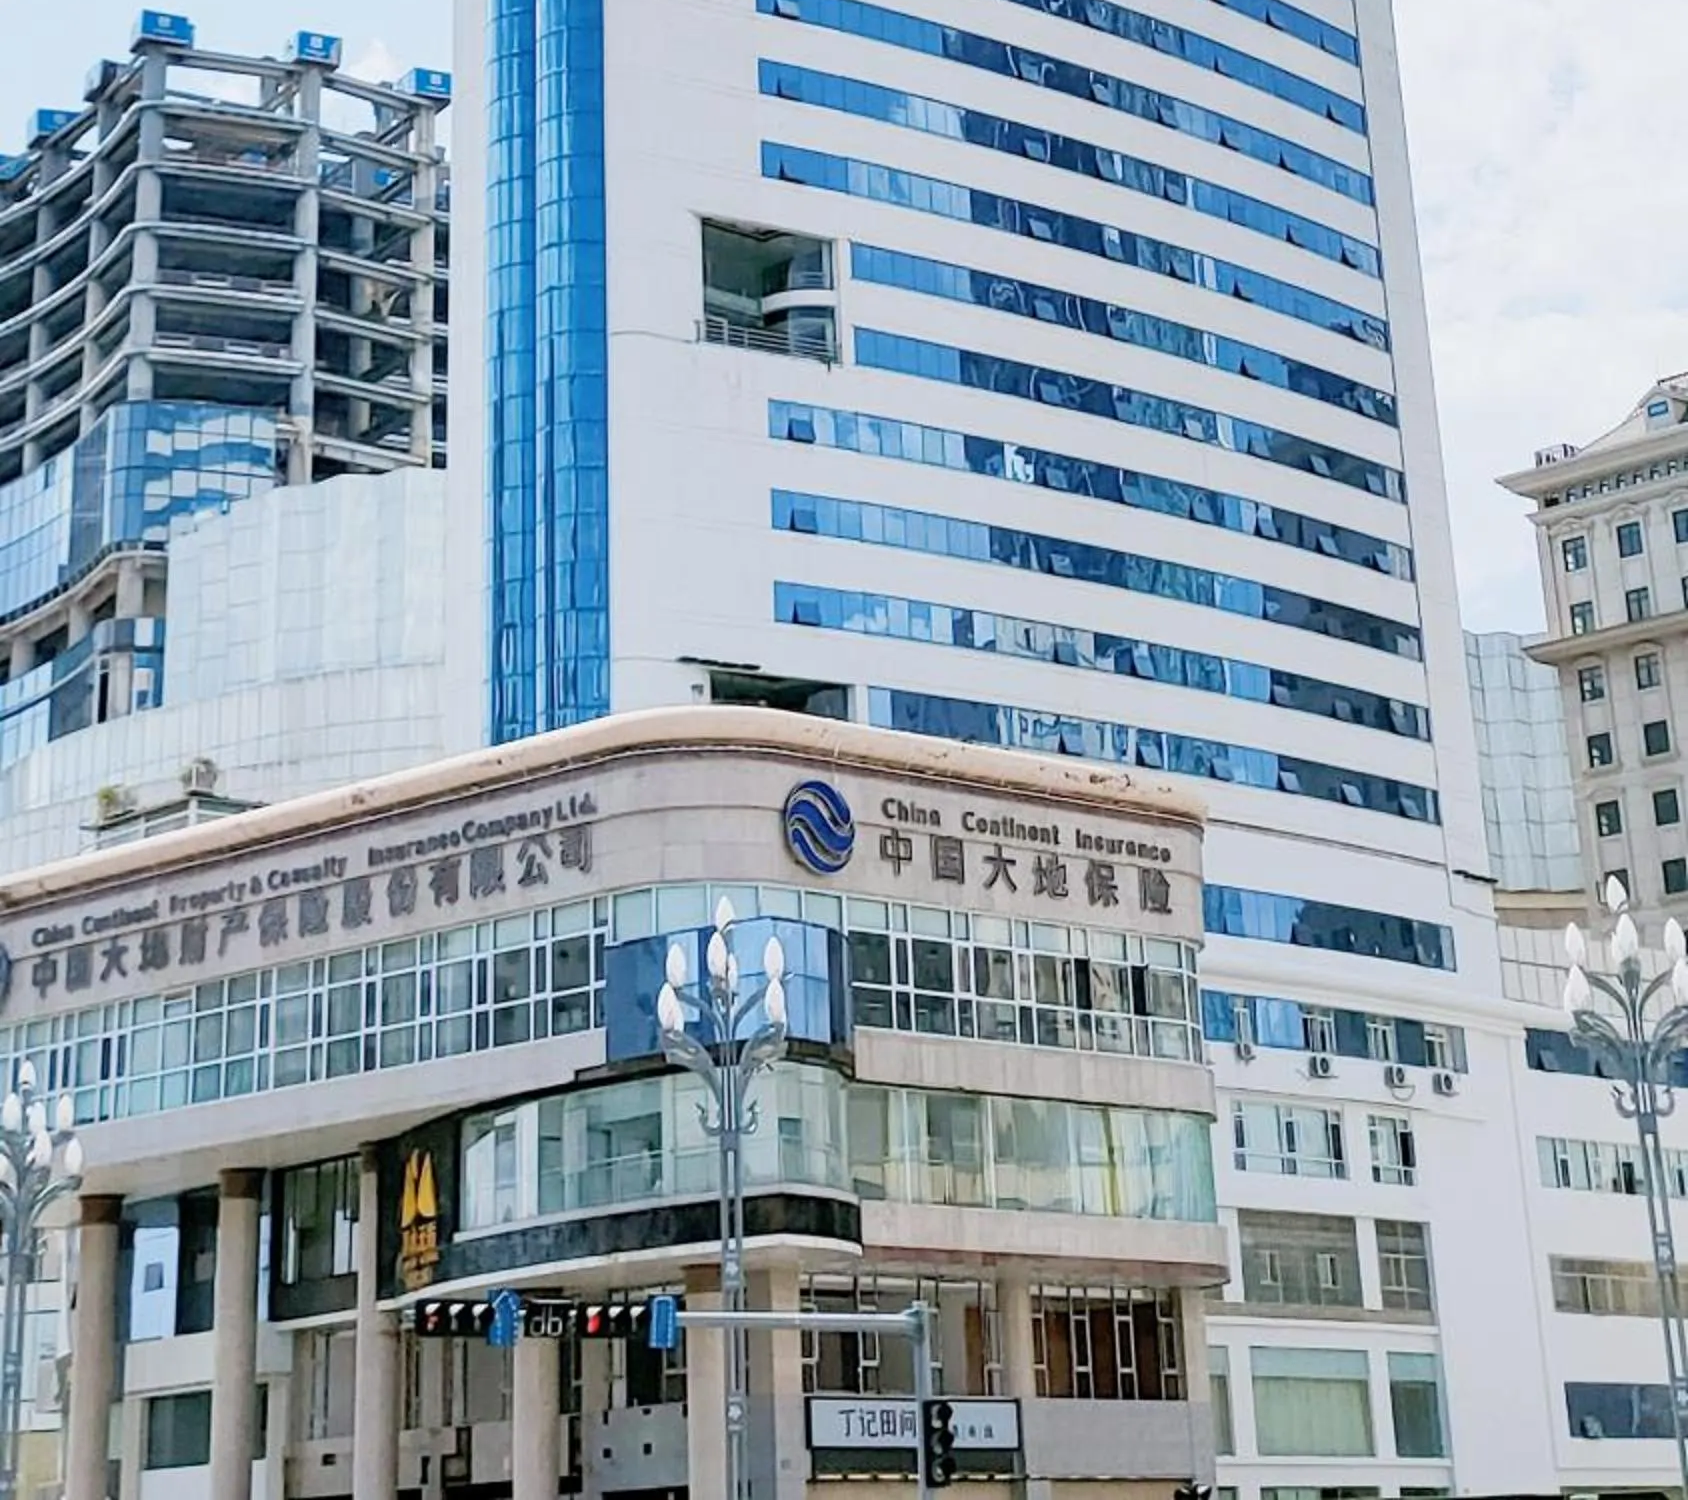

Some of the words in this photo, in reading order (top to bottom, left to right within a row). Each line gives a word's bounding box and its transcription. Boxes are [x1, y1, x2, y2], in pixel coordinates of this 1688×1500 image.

[879, 827, 1173, 915] 中国大地保险
[881, 797, 941, 828] China
[962, 810, 1061, 846] Continent
[1075, 829, 1171, 863] Insurance
[31, 923, 75, 947] China
[81, 899, 159, 936] Continent
[169, 879, 246, 914] Property
[249, 875, 263, 896] &
[267, 856, 347, 889] Casualty
[368, 830, 460, 866] Insurance
[461, 805, 552, 843] Company
